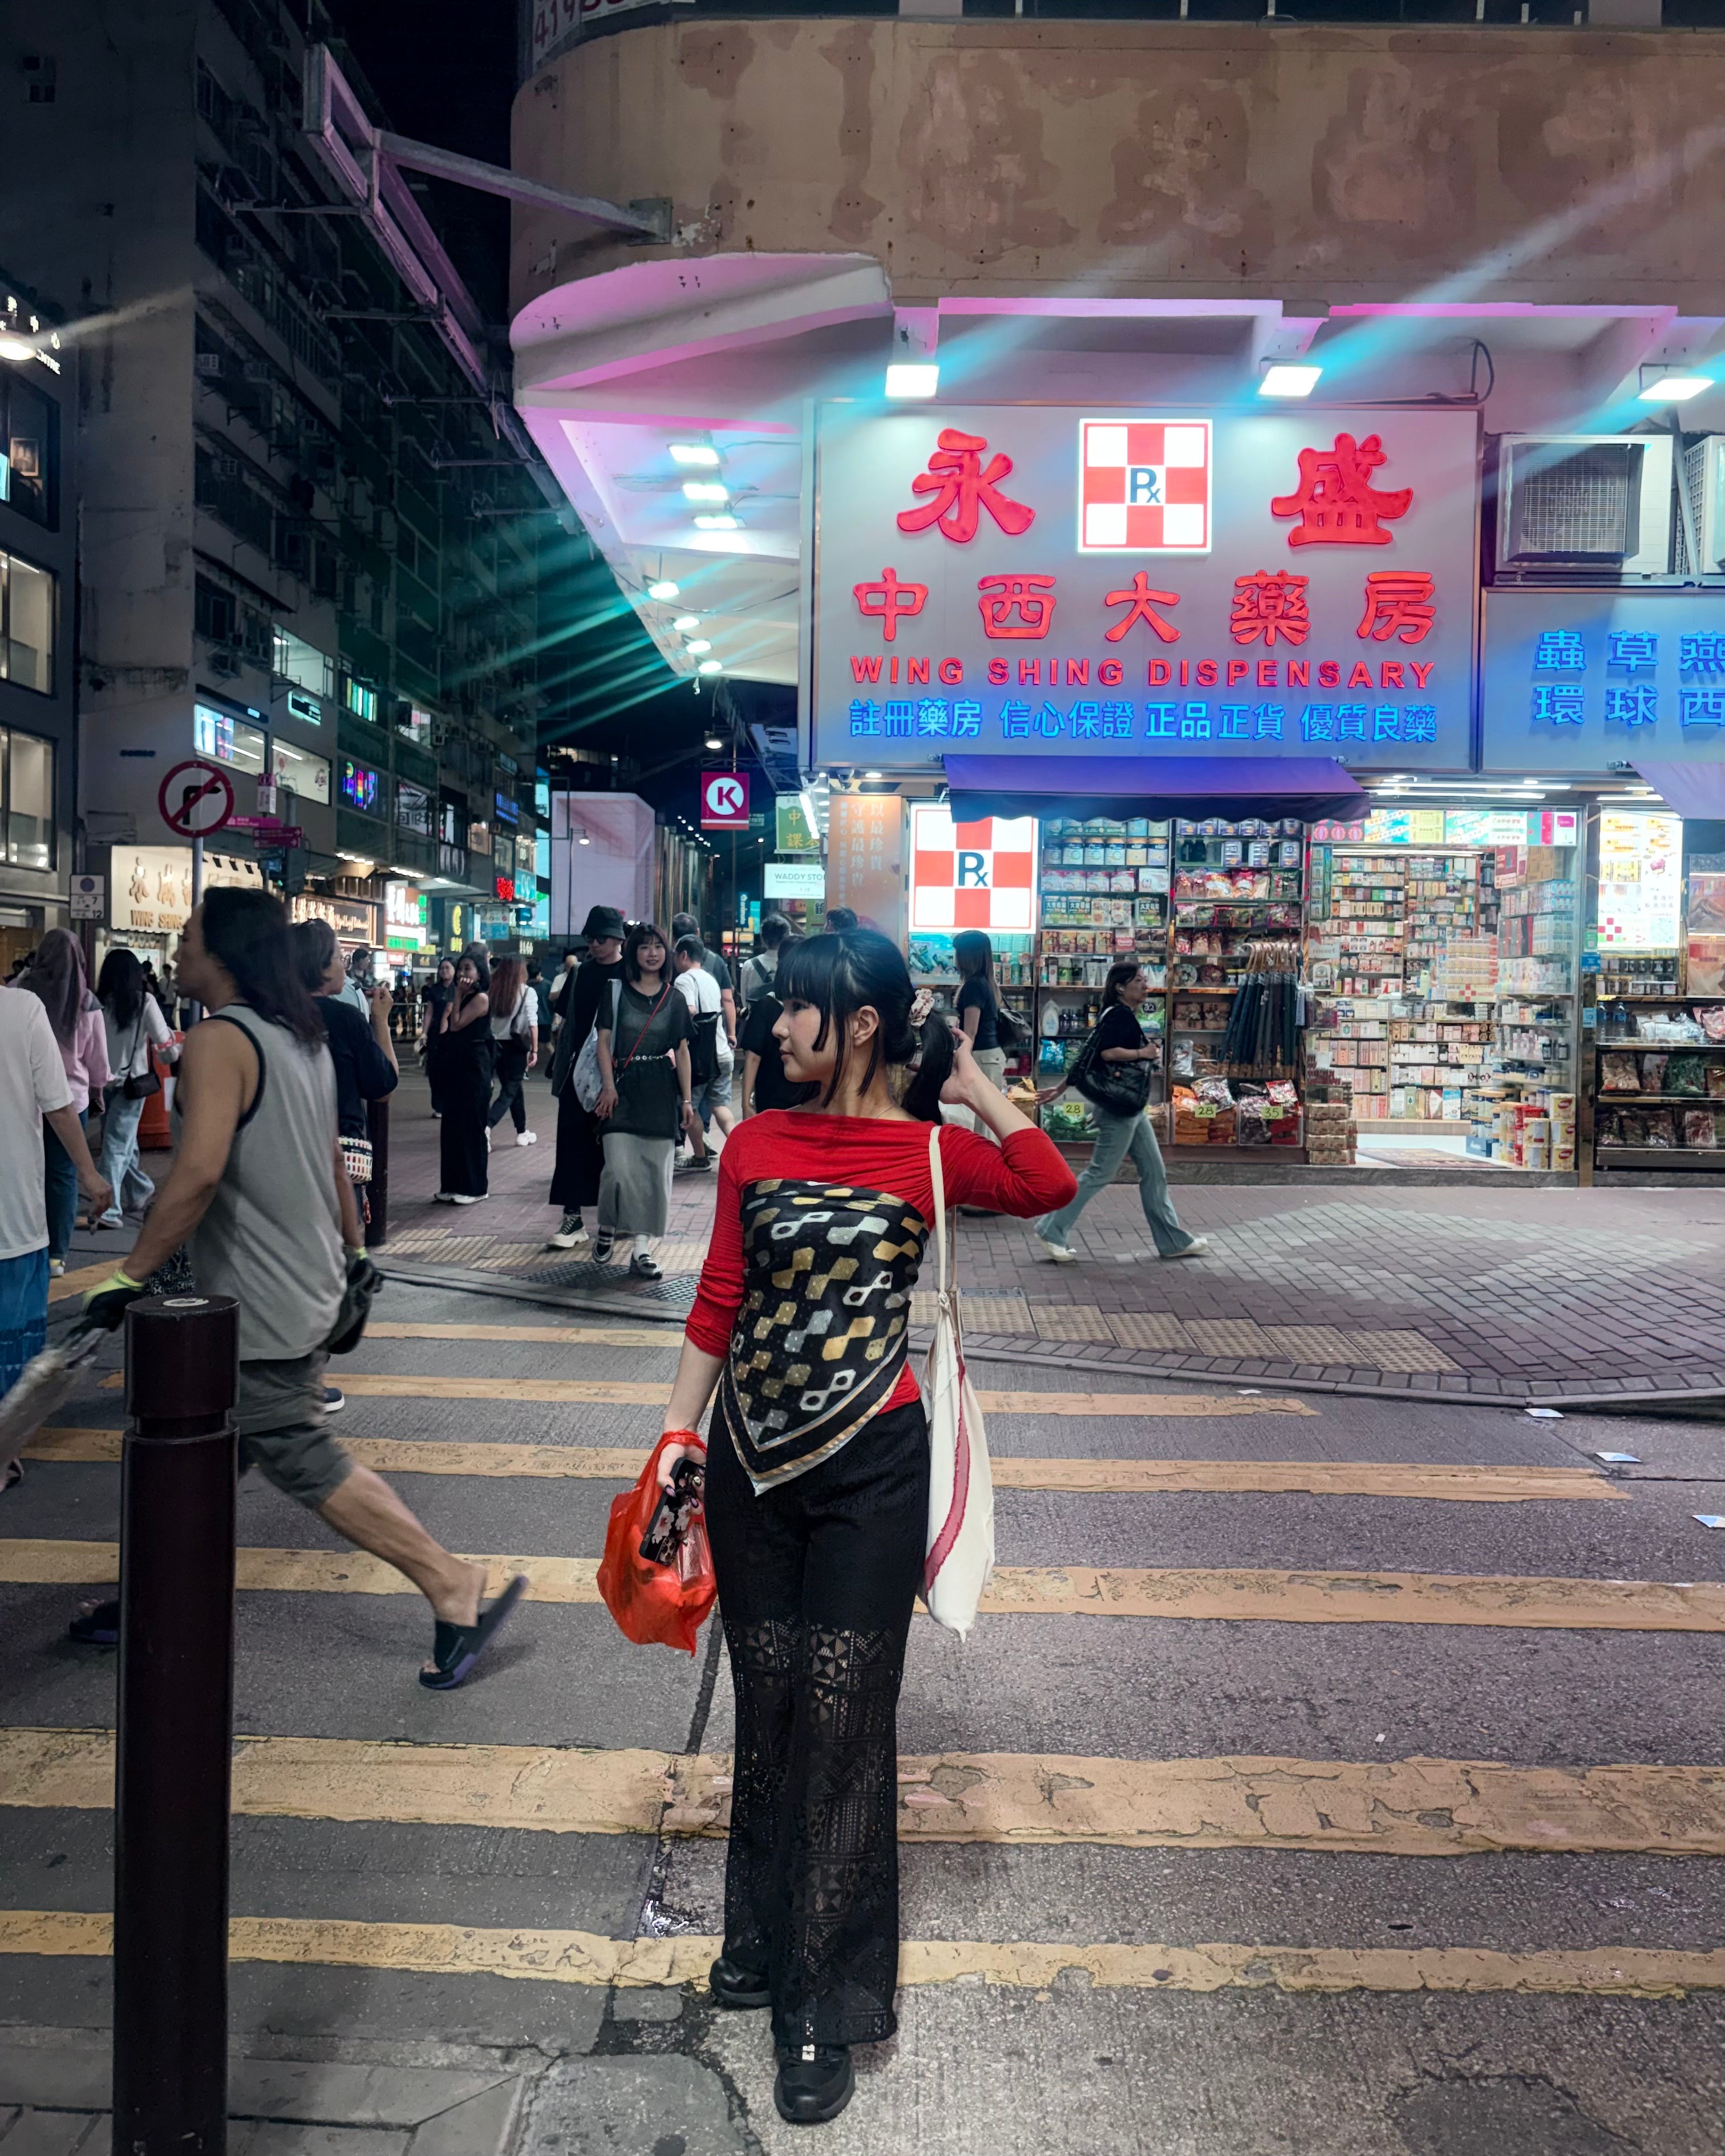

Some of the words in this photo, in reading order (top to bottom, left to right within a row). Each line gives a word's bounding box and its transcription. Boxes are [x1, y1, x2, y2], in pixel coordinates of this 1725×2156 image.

[897, 428, 1035, 545] 永
[1270, 432, 1414, 547] 盛
[853, 568, 1436, 646] 中西大藥房
[1534, 629, 1725, 672] 蟲草燕
[851, 656, 963, 684] WING
[988, 658, 1123, 686] SHING
[1148, 659, 1434, 690] DISPENSARY
[849, 697, 982, 739] 註冊藥房
[999, 699, 1133, 740] 信心保證
[1145, 702, 1285, 742] 正品正貨
[1299, 703, 1437, 743] 優質良藥
[1533, 684, 1725, 727] 環球西
[718, 787, 739, 811] K
[131, 910, 153, 927] WING
[1066, 1105, 1080, 1114] 28
[1198, 1106, 1214, 1115] 28
[1264, 1108, 1279, 1117] 35
